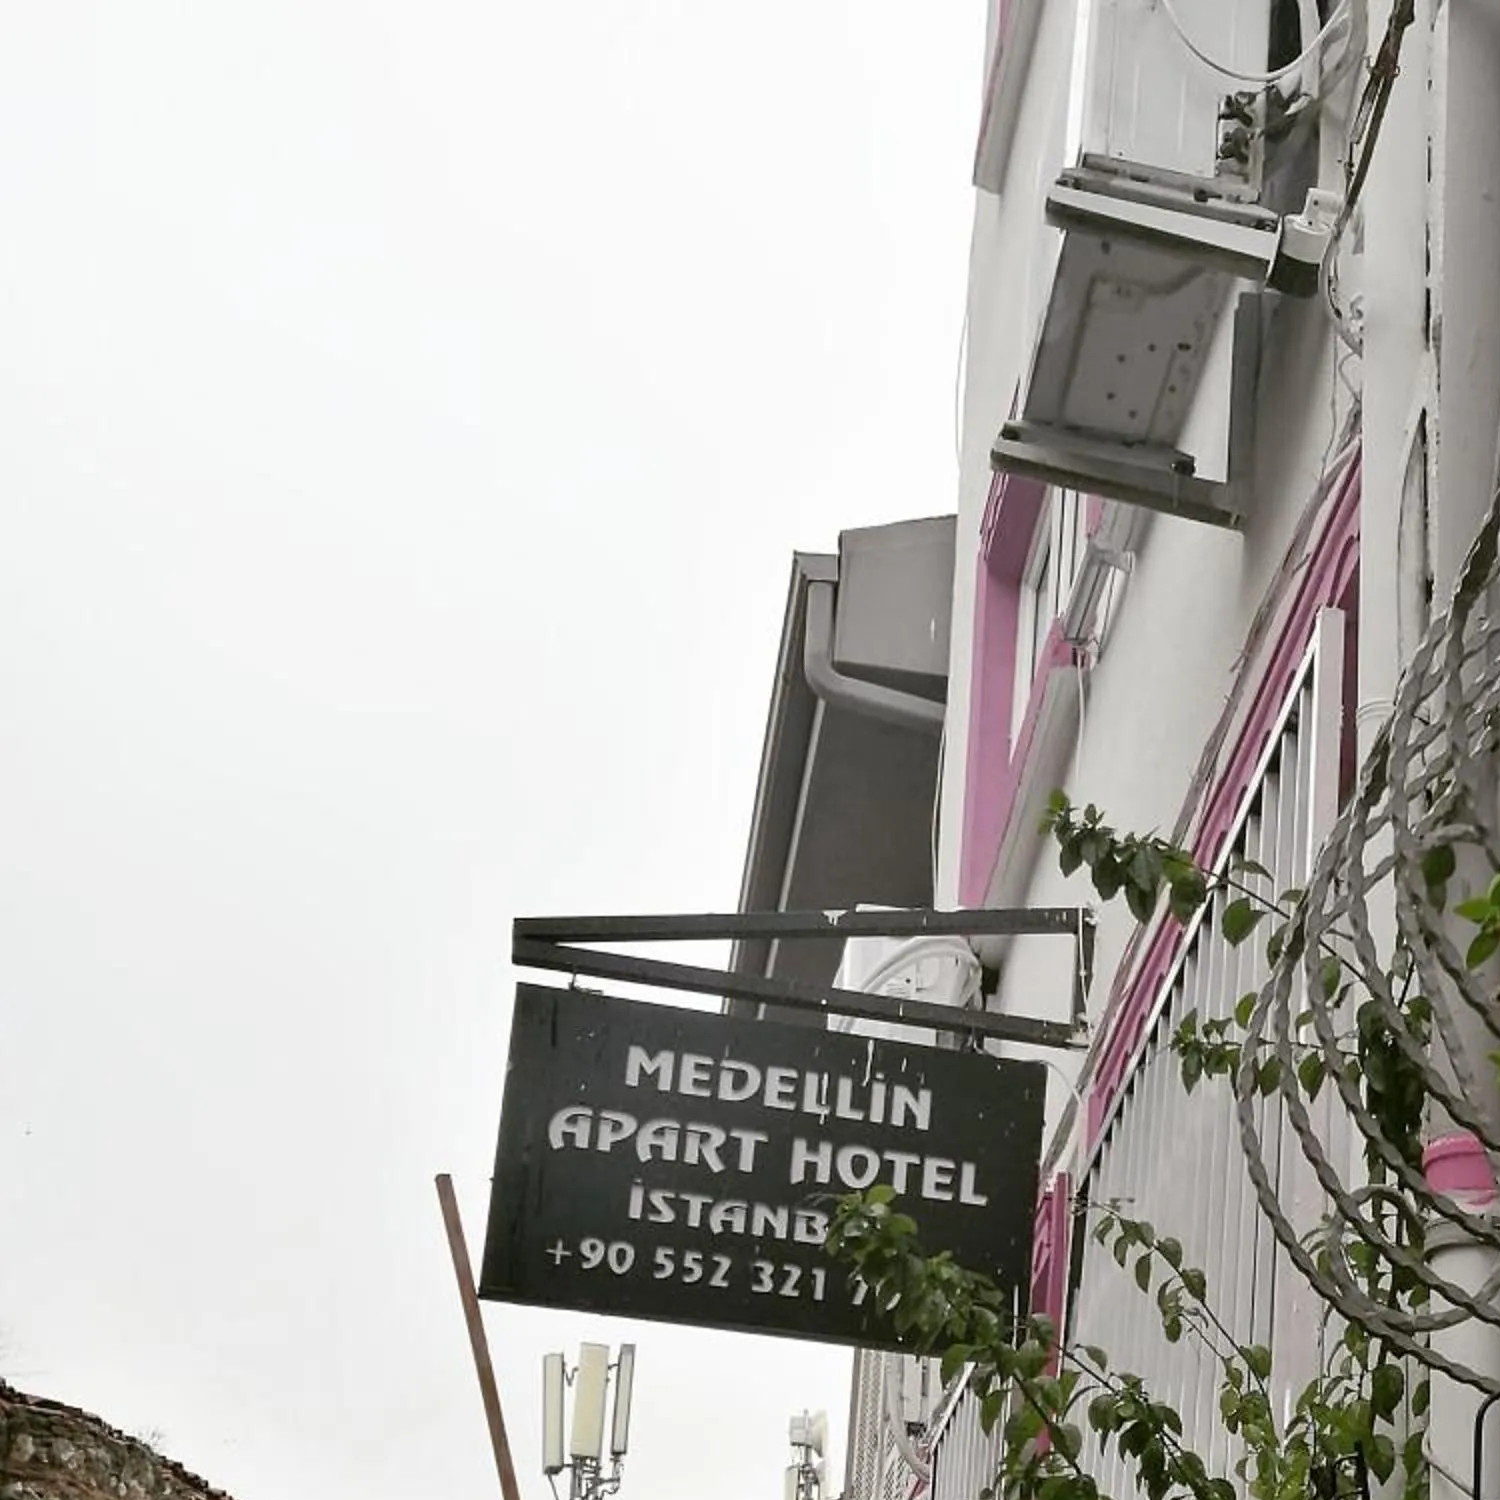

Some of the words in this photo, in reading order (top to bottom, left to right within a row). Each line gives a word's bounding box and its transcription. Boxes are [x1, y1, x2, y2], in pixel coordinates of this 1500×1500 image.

[548, 1105, 769, 1172] APART
[790, 1137, 989, 1207] HOTEL
[627, 1177, 829, 1245] İSTANB
[546, 1238, 636, 1276] +90
[653, 1246, 732, 1288] 552
[751, 1259, 827, 1301] 321
